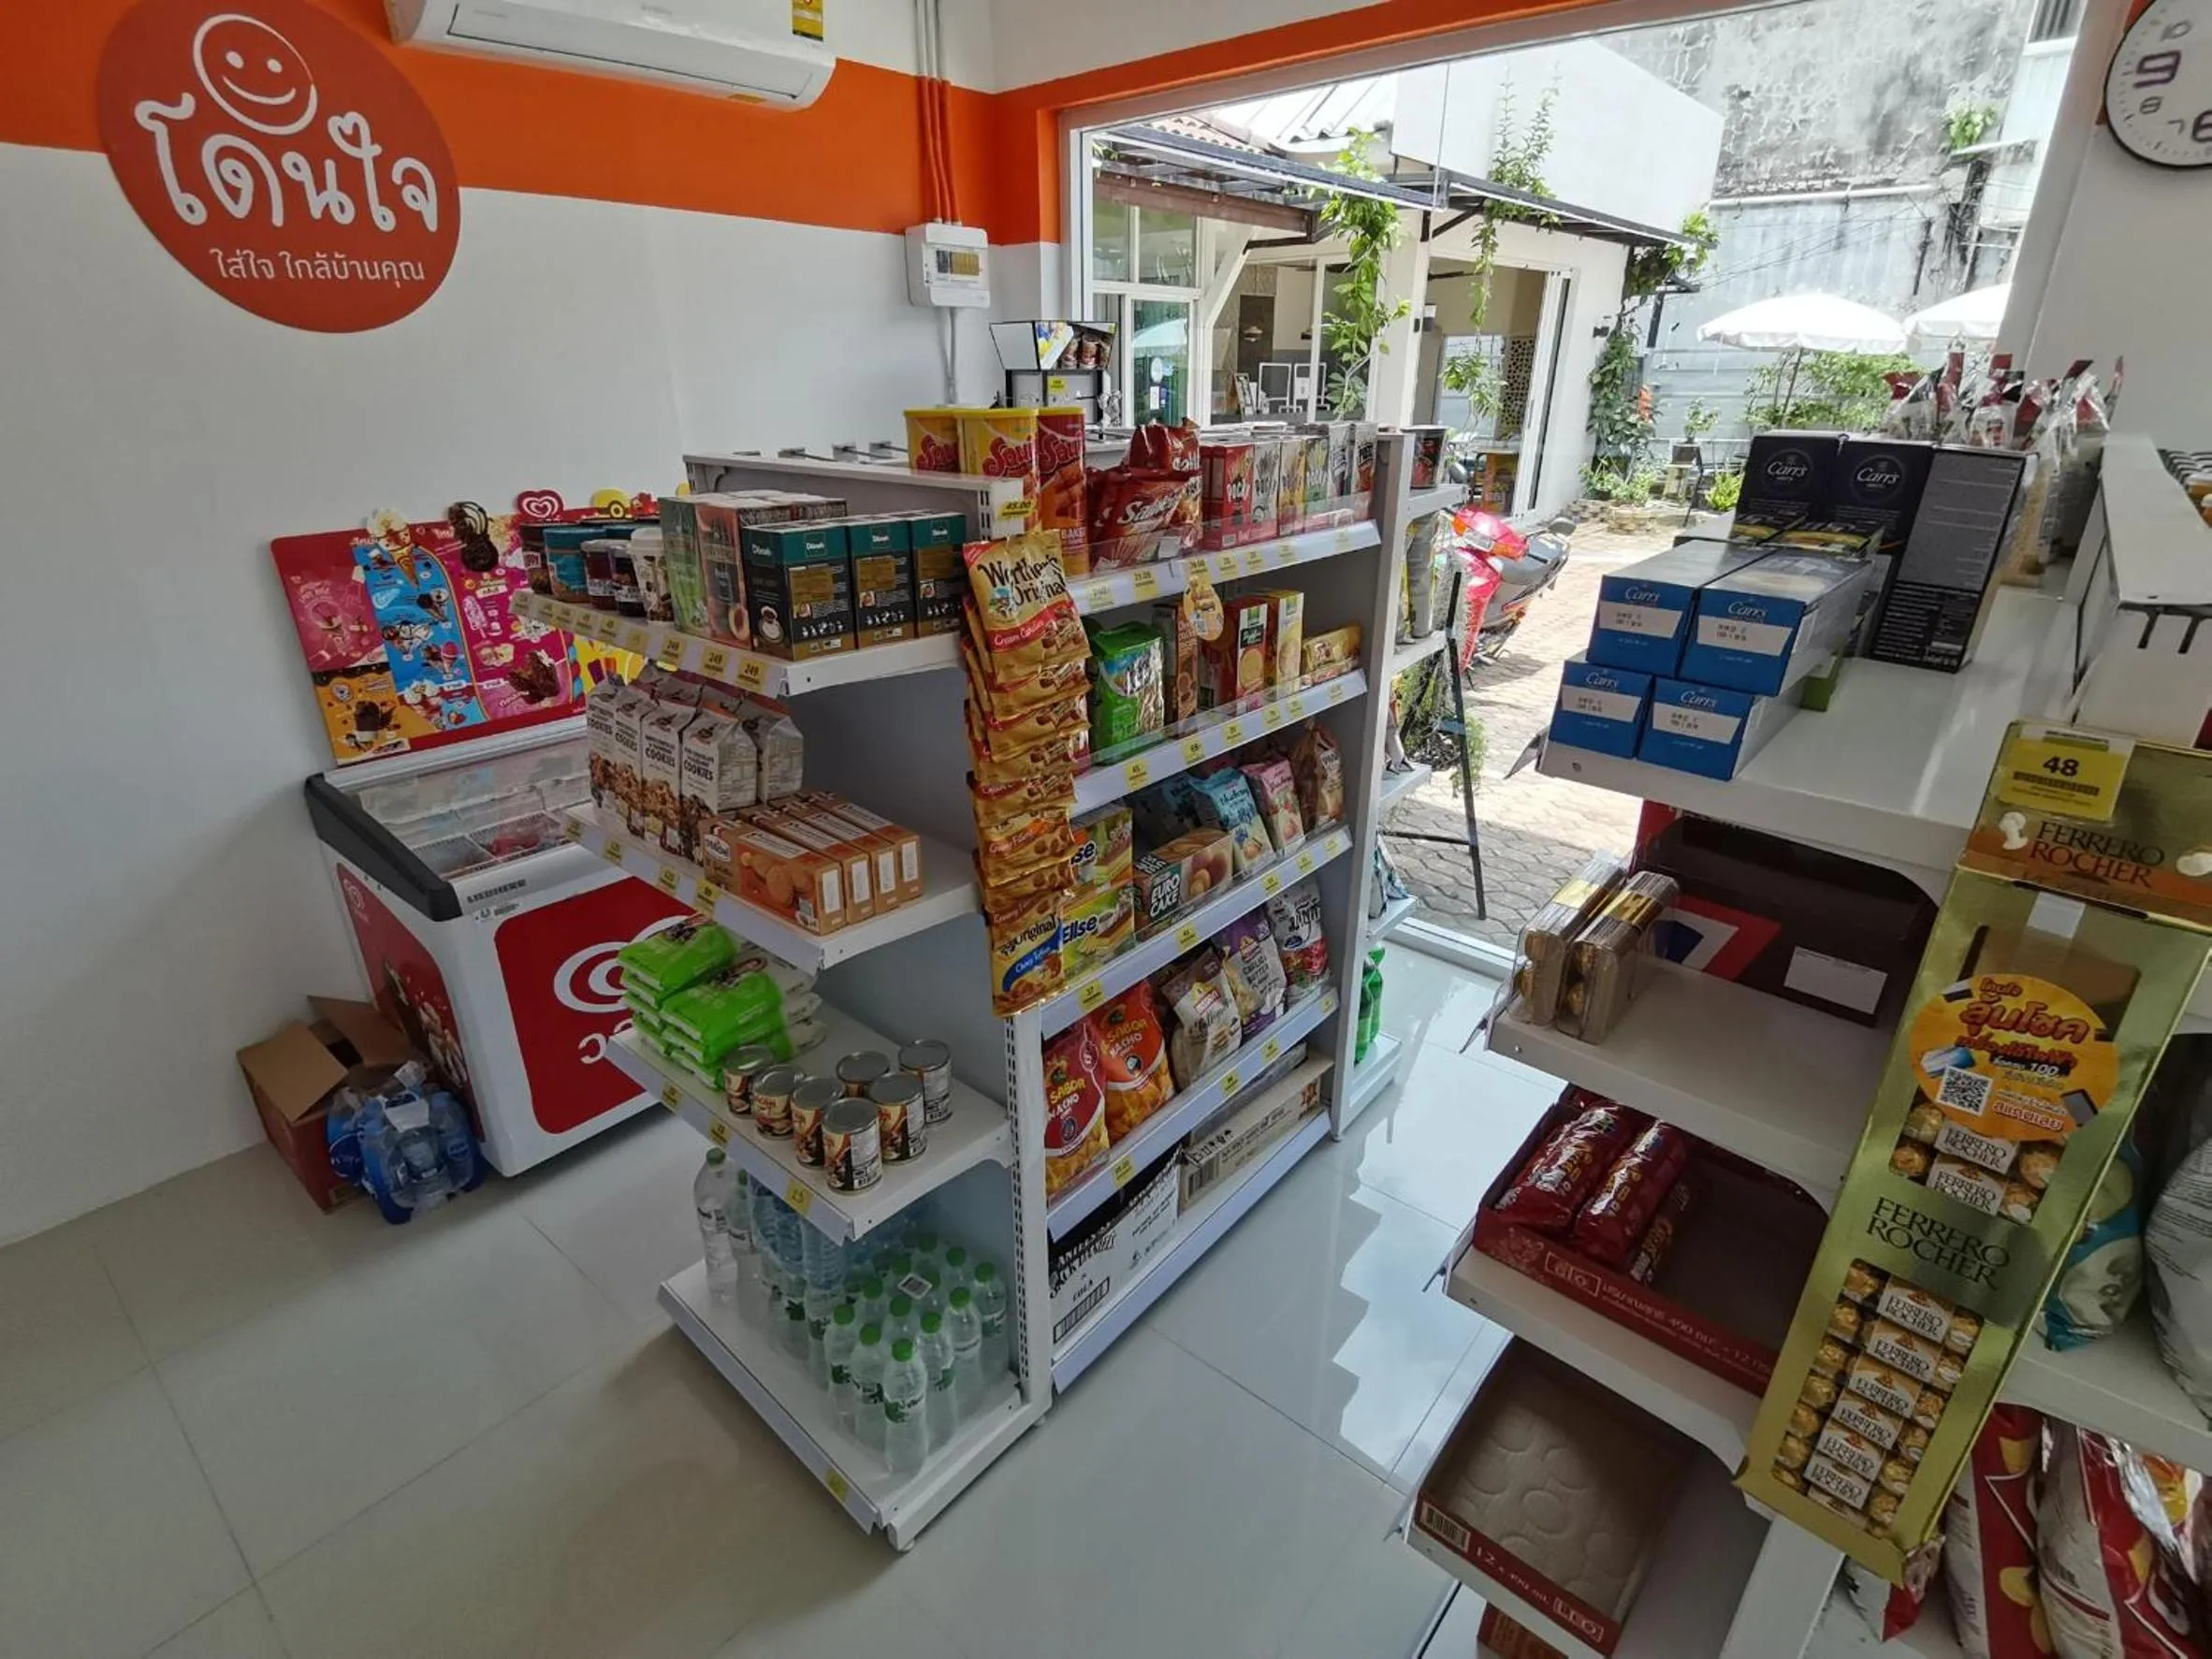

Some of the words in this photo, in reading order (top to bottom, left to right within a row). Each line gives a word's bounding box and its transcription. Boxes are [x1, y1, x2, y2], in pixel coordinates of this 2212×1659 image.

[2133, 51, 2181, 88] 9
[2139, 95, 2163, 114] 8
[135, 92, 439, 232] โดนใจ
[210, 248, 276, 280] ใส่ใจ
[280, 251, 426, 288] ใกล้บ้านคุณ
[2043, 756, 2079, 778] 48
[2037, 821, 2165, 867] FERRERO
[2030, 843, 2152, 889] ROCHER
[1150, 893, 1180, 918] CAKE
[1151, 876, 1181, 901] EURO
[1959, 994, 2089, 1043] ลุ้นโชค
[1049, 1077, 1086, 1105] SABOR
[1937, 1168, 1998, 1204] FERRERO
[1873, 1196, 2011, 1267] FERRERO
[1866, 1219, 1998, 1290] ROCHER
